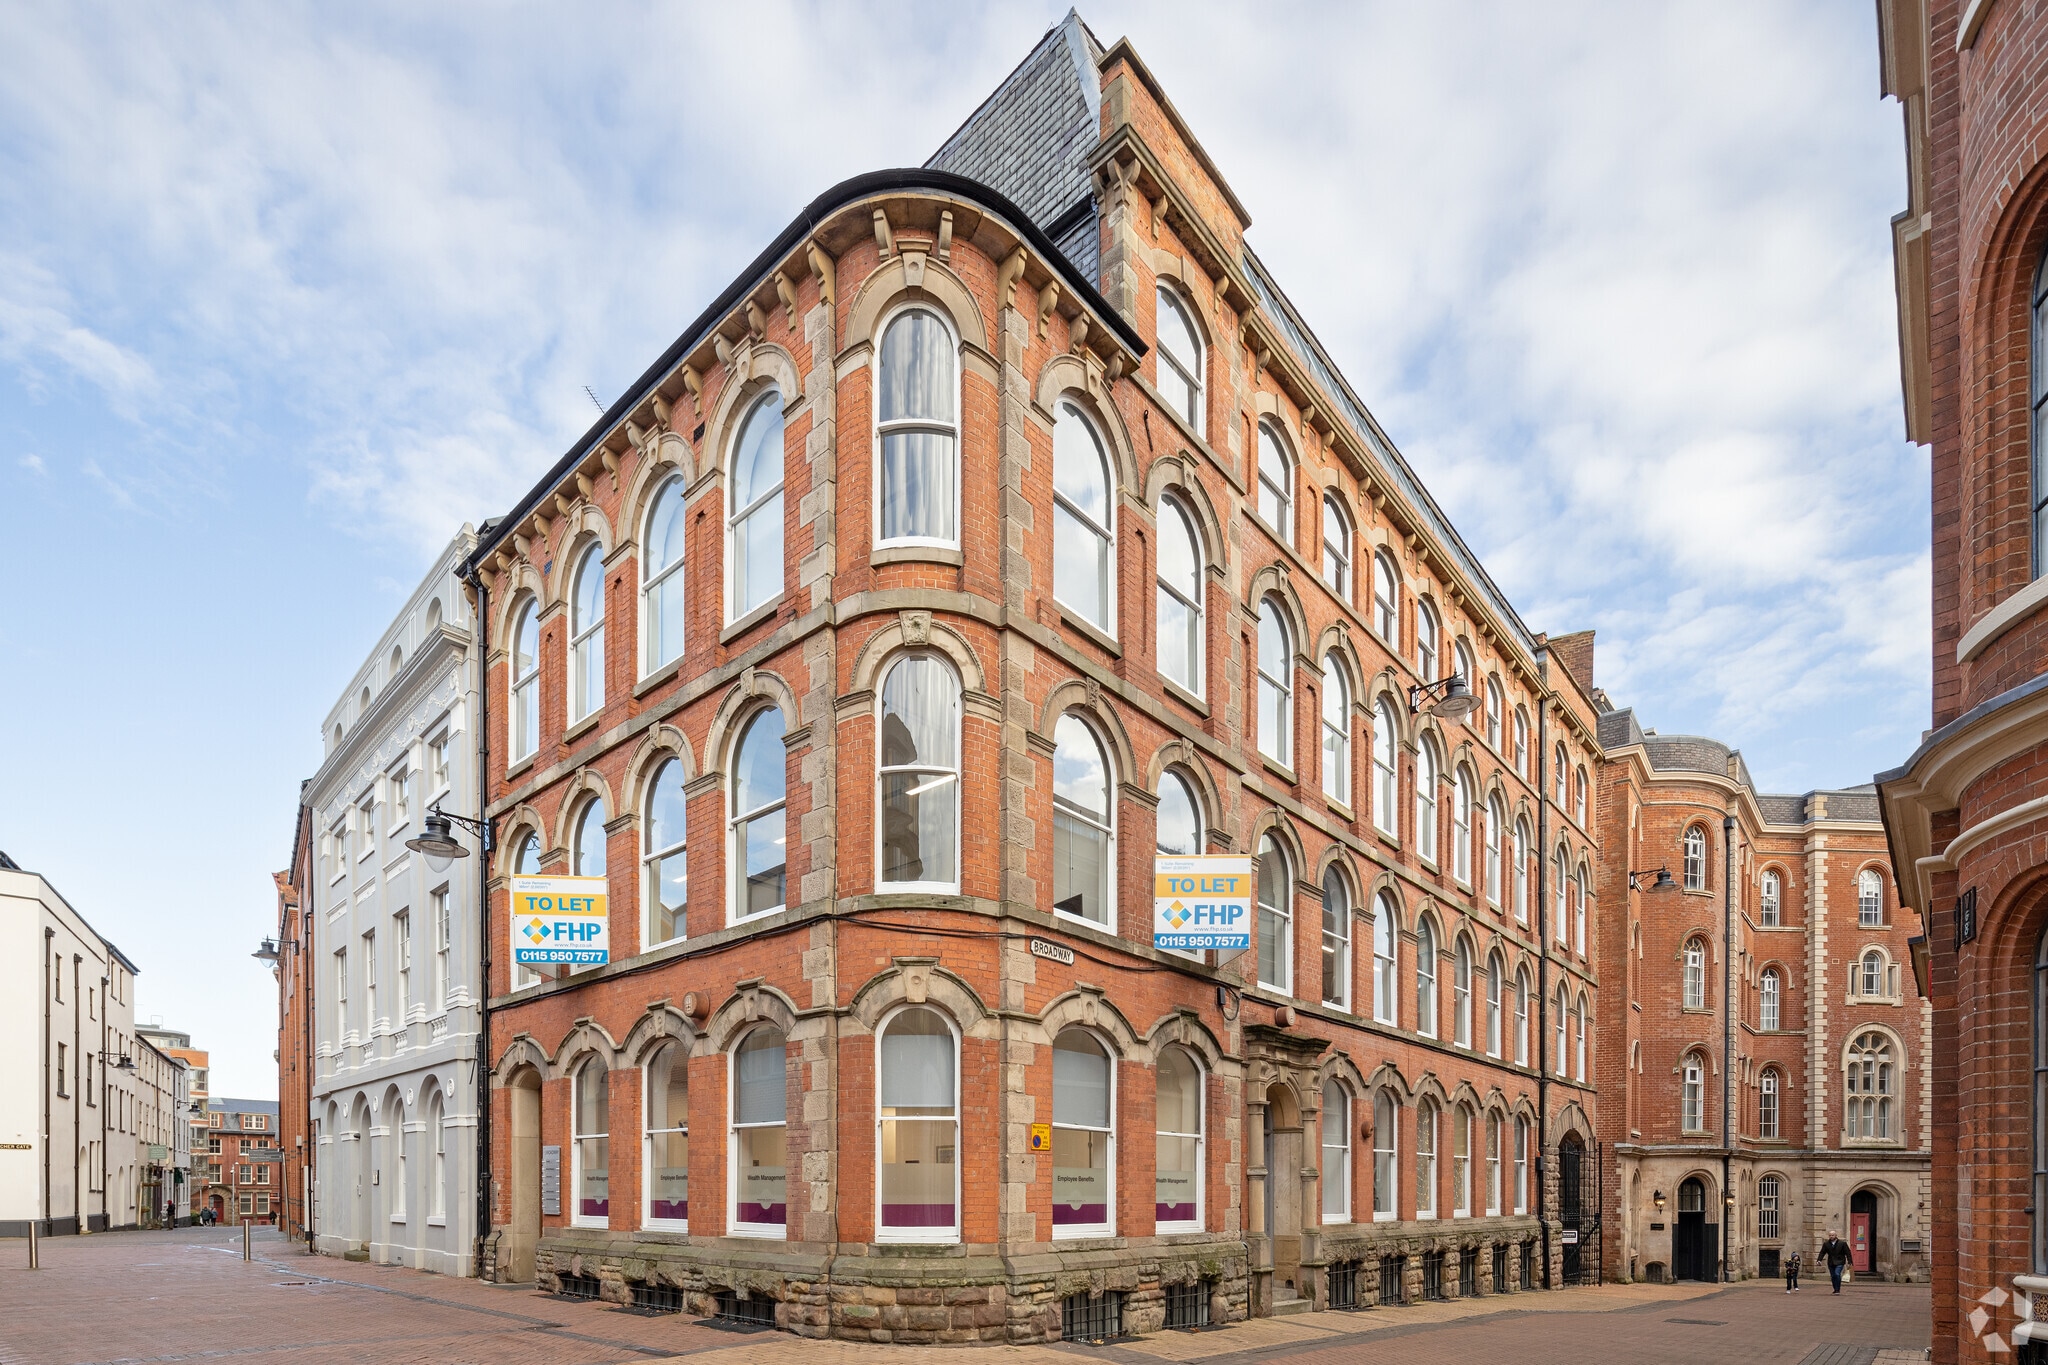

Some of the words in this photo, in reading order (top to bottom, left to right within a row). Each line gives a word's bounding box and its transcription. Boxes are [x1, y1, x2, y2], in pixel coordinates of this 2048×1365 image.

[1168, 878, 1195, 892] TO
[1201, 878, 1238, 892] LET
[526, 897, 552, 910] TO
[558, 897, 594, 911] LET
[1194, 905, 1243, 925] FHP
[554, 922, 601, 941] FHP
[1160, 936, 1186, 946] 0115
[1189, 936, 1212, 946] 950
[1215, 936, 1244, 946] 7577
[521, 951, 548, 960] 0115
[550, 951, 573, 961] 950
[574, 952, 603, 961] 7577
[1034, 941, 1070, 961] BROADWAY
